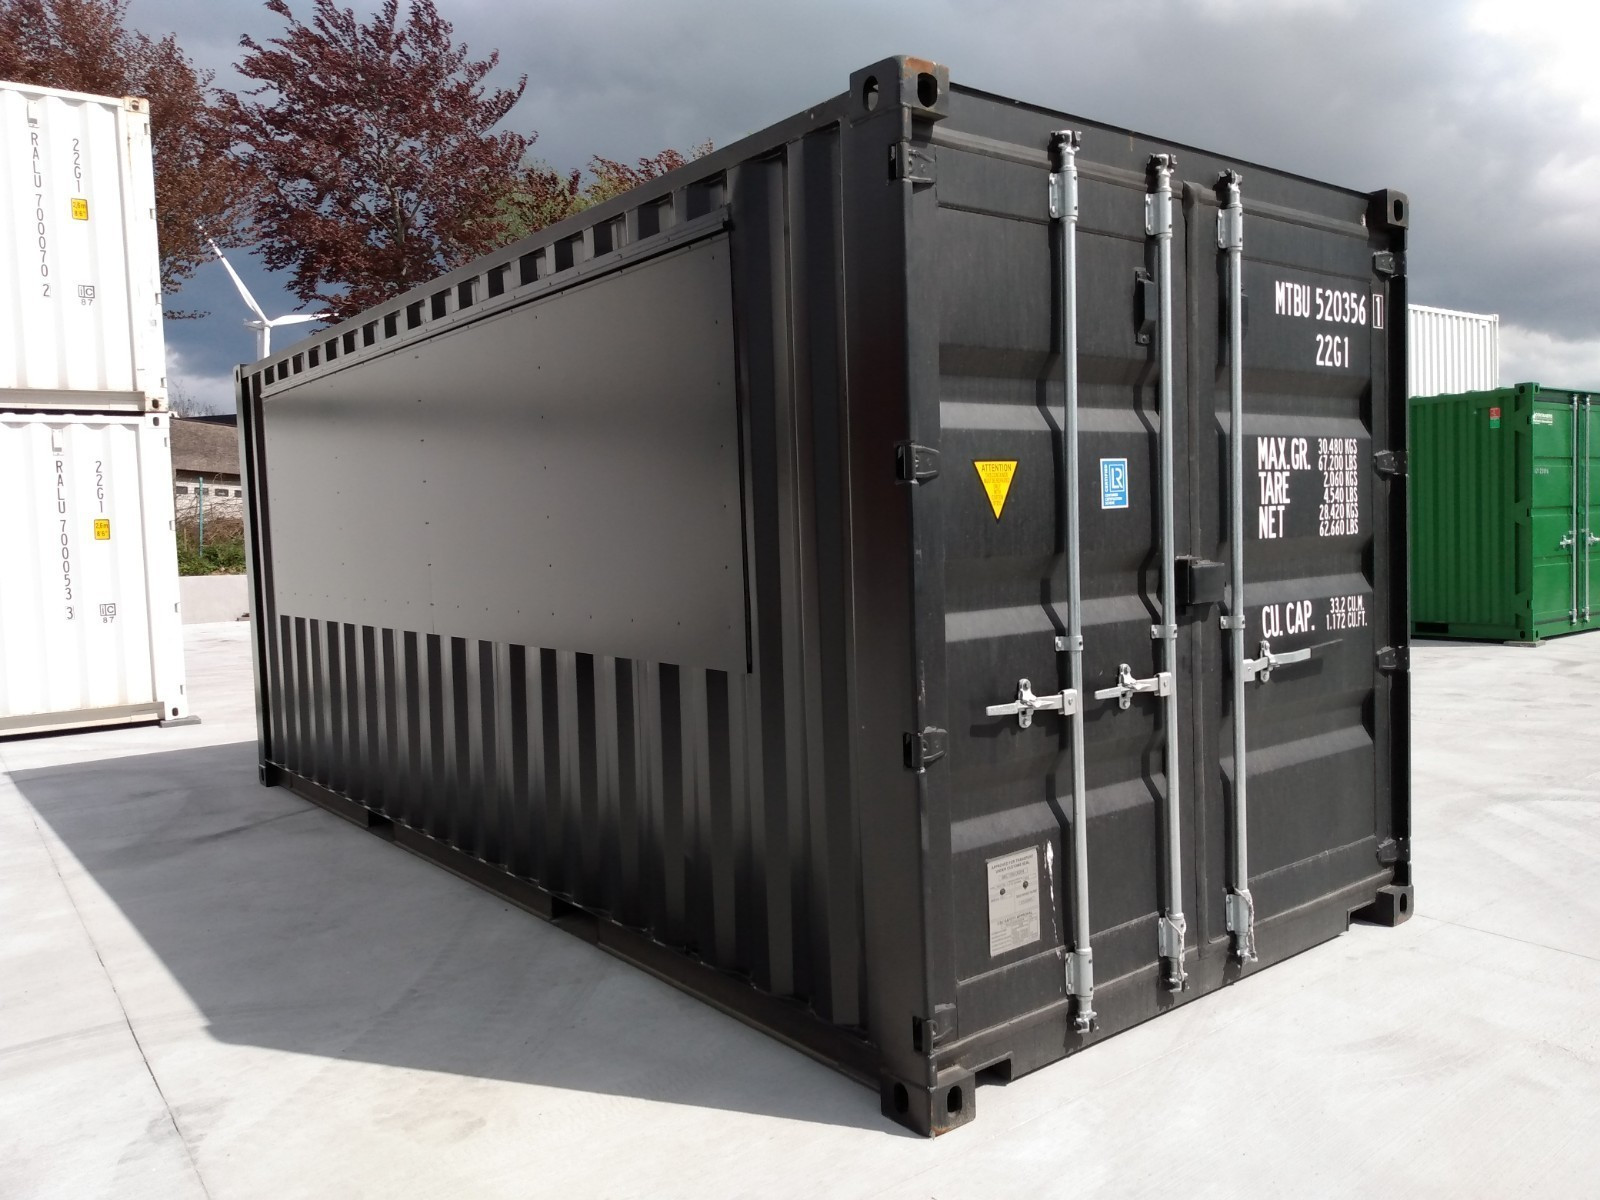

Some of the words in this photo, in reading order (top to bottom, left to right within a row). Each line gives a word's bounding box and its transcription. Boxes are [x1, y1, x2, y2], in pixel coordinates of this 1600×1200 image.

[30, 132, 42, 188] RALU
[72, 138, 82, 193] 22G1
[35, 194, 49, 277] 700070
[43, 283, 50, 297] 2
[81, 298, 93, 306] 87
[1275, 280, 1311, 318] MTBU
[1315, 287, 1367, 325] 520356
[1374, 295, 1382, 328] 1
[1315, 333, 1349, 368] 22G1
[1318, 438, 1344, 455] 30.480
[1344, 438, 1358, 454] KGS
[981, 463, 1012, 472] ATTENTION
[1318, 454, 1344, 471] 67.200
[1344, 454, 1358, 471] LBS
[55, 460, 66, 514] RALU
[95, 460, 104, 513] 22G1
[1111, 467, 1123, 489] LR
[1323, 470, 1344, 488] 2.060
[1345, 470, 1358, 487] KGS
[1258, 471, 1291, 505] TARE
[1323, 487, 1344, 504] 4.540
[1345, 486, 1358, 503] LBS
[1319, 503, 1345, 521] 28.420
[1345, 502, 1359, 519] KGS
[1258, 505, 1286, 540] NET
[1319, 519, 1345, 537] 62.660
[1346, 518, 1359, 535] LBS
[60, 519, 72, 601] 700053
[66, 605, 74, 620] 3
[1329, 596, 1346, 614] 33.2
[102, 616, 115, 624] 87
[1261, 603, 1284, 639] CU.
[1285, 599, 1316, 635] CAP.
[1326, 612, 1346, 631] 1.172
